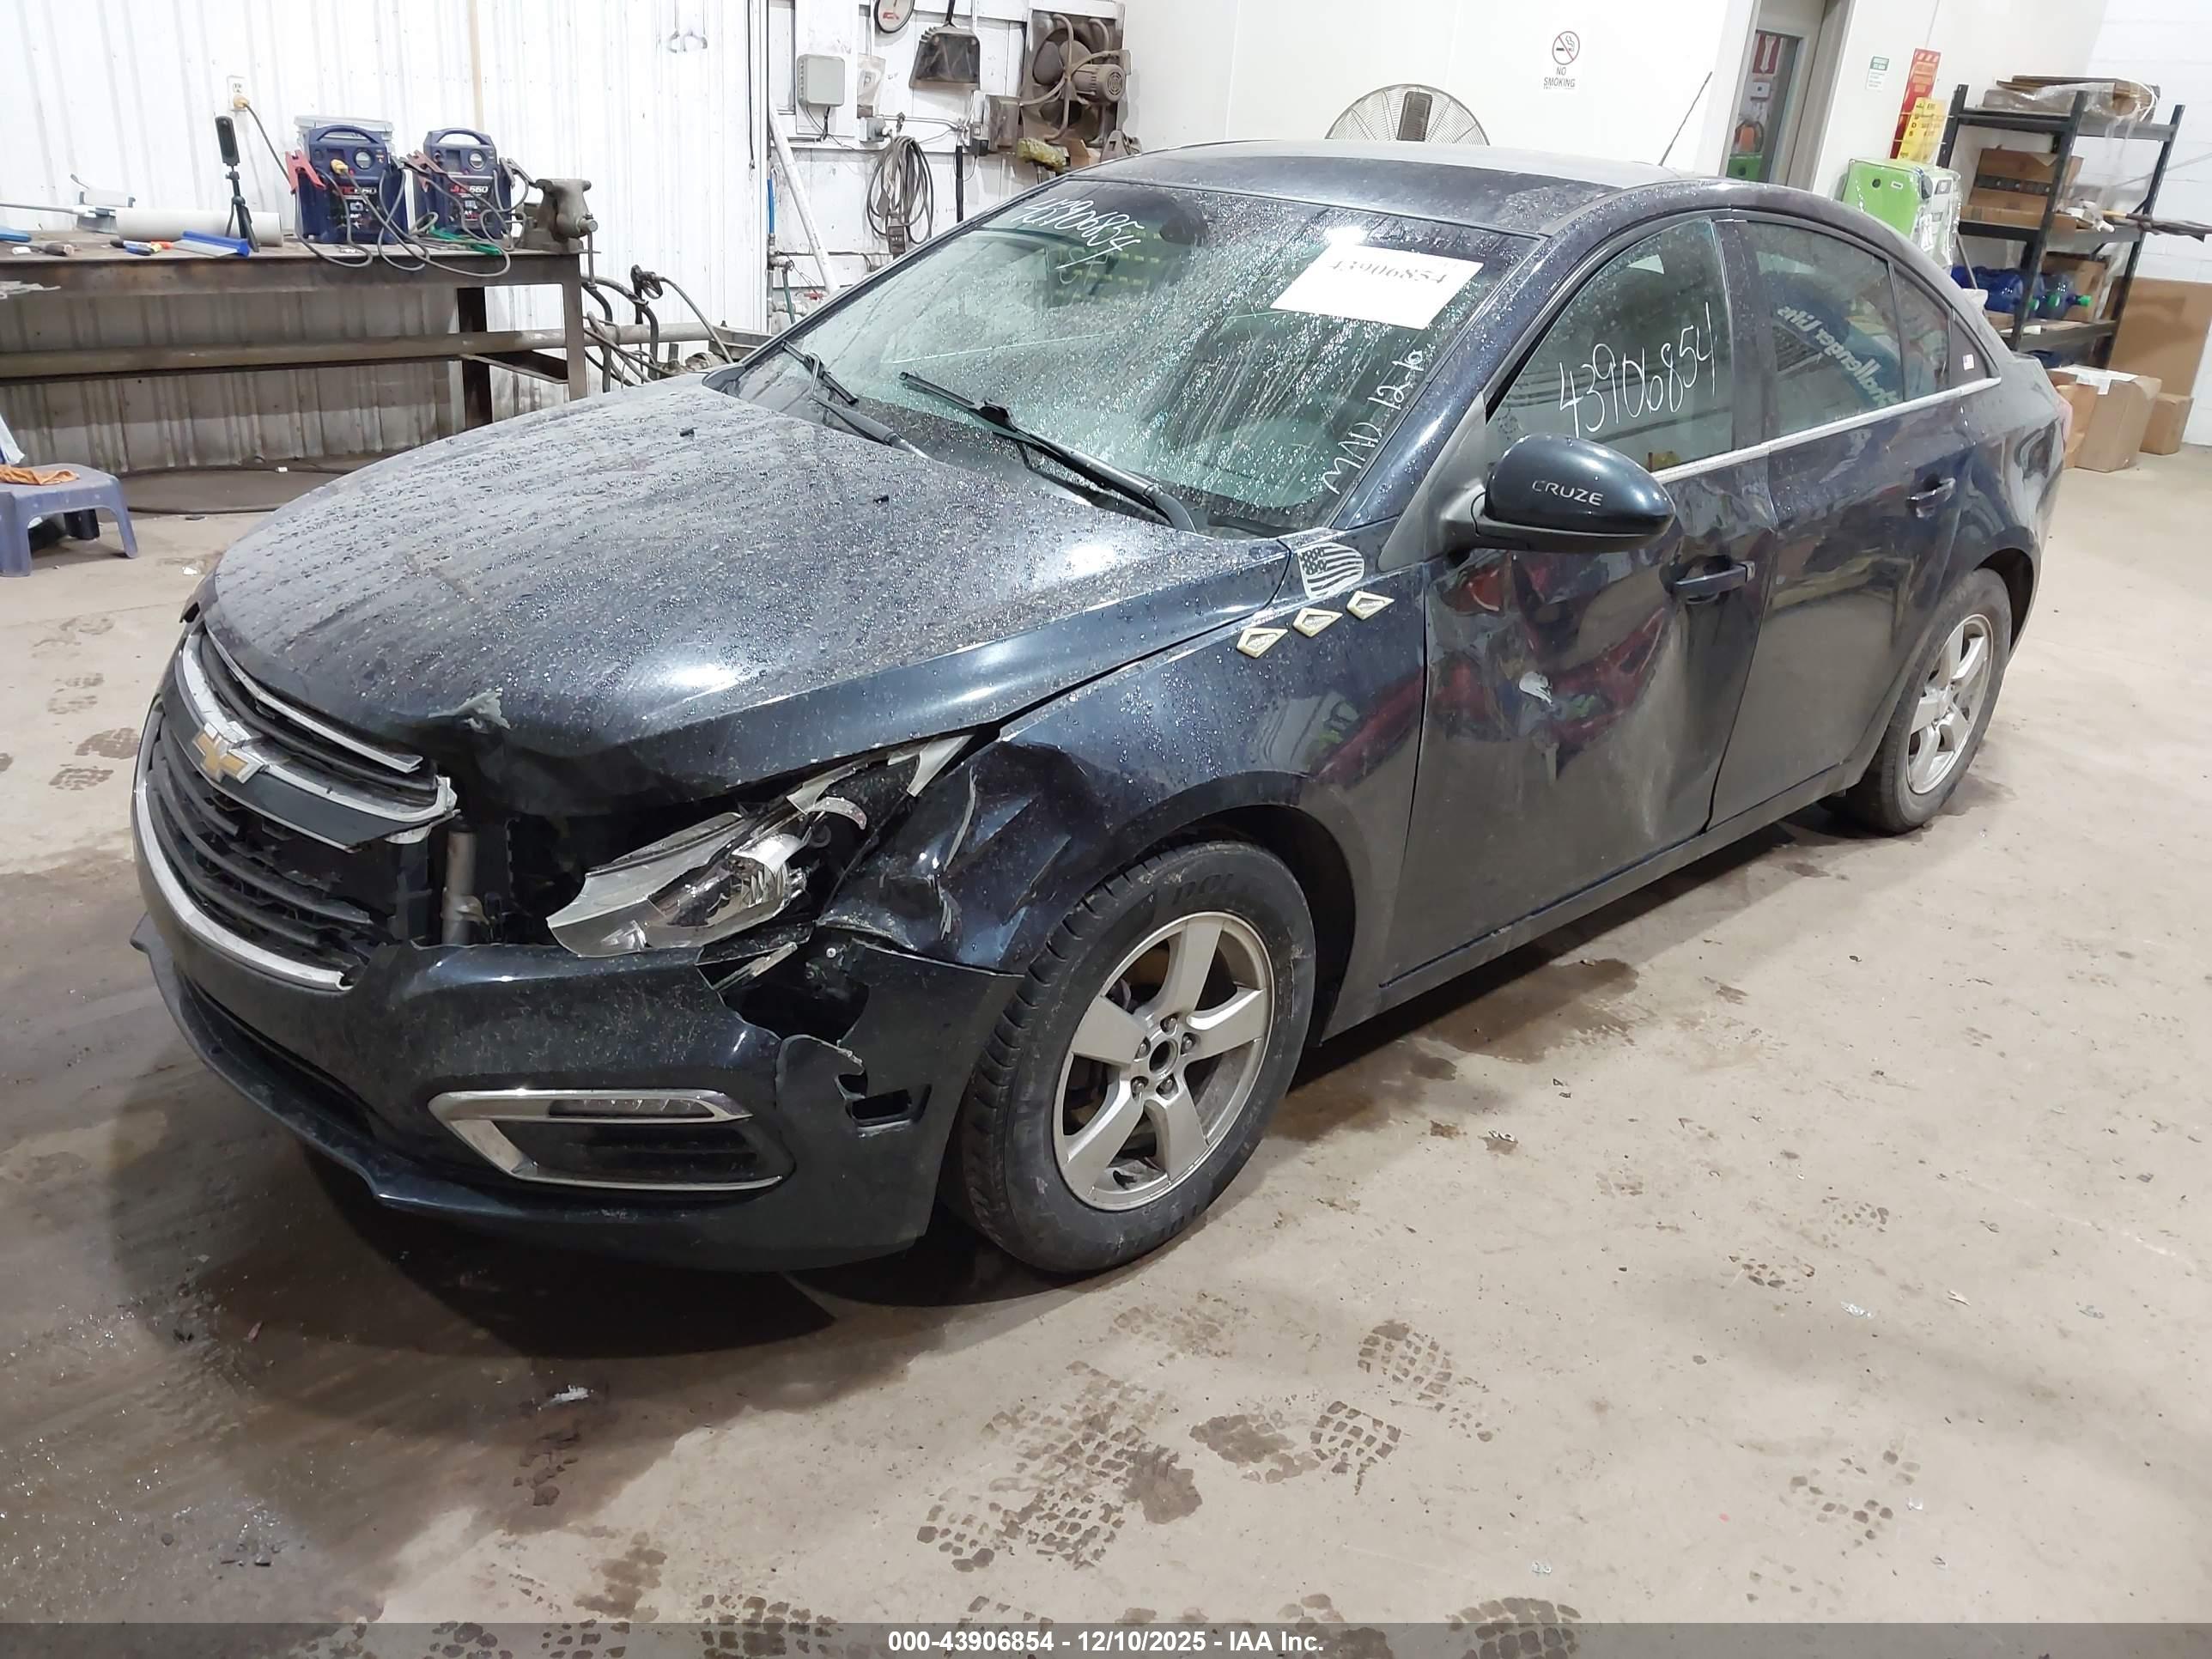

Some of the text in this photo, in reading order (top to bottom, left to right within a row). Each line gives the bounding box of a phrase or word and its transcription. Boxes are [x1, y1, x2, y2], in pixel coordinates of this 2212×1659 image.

[1556, 67, 1567, 76] NO
[1543, 77, 1576, 87] SMOKING
[1559, 301, 1716, 438] 43906854
[1531, 479, 1604, 507] CRUZE
